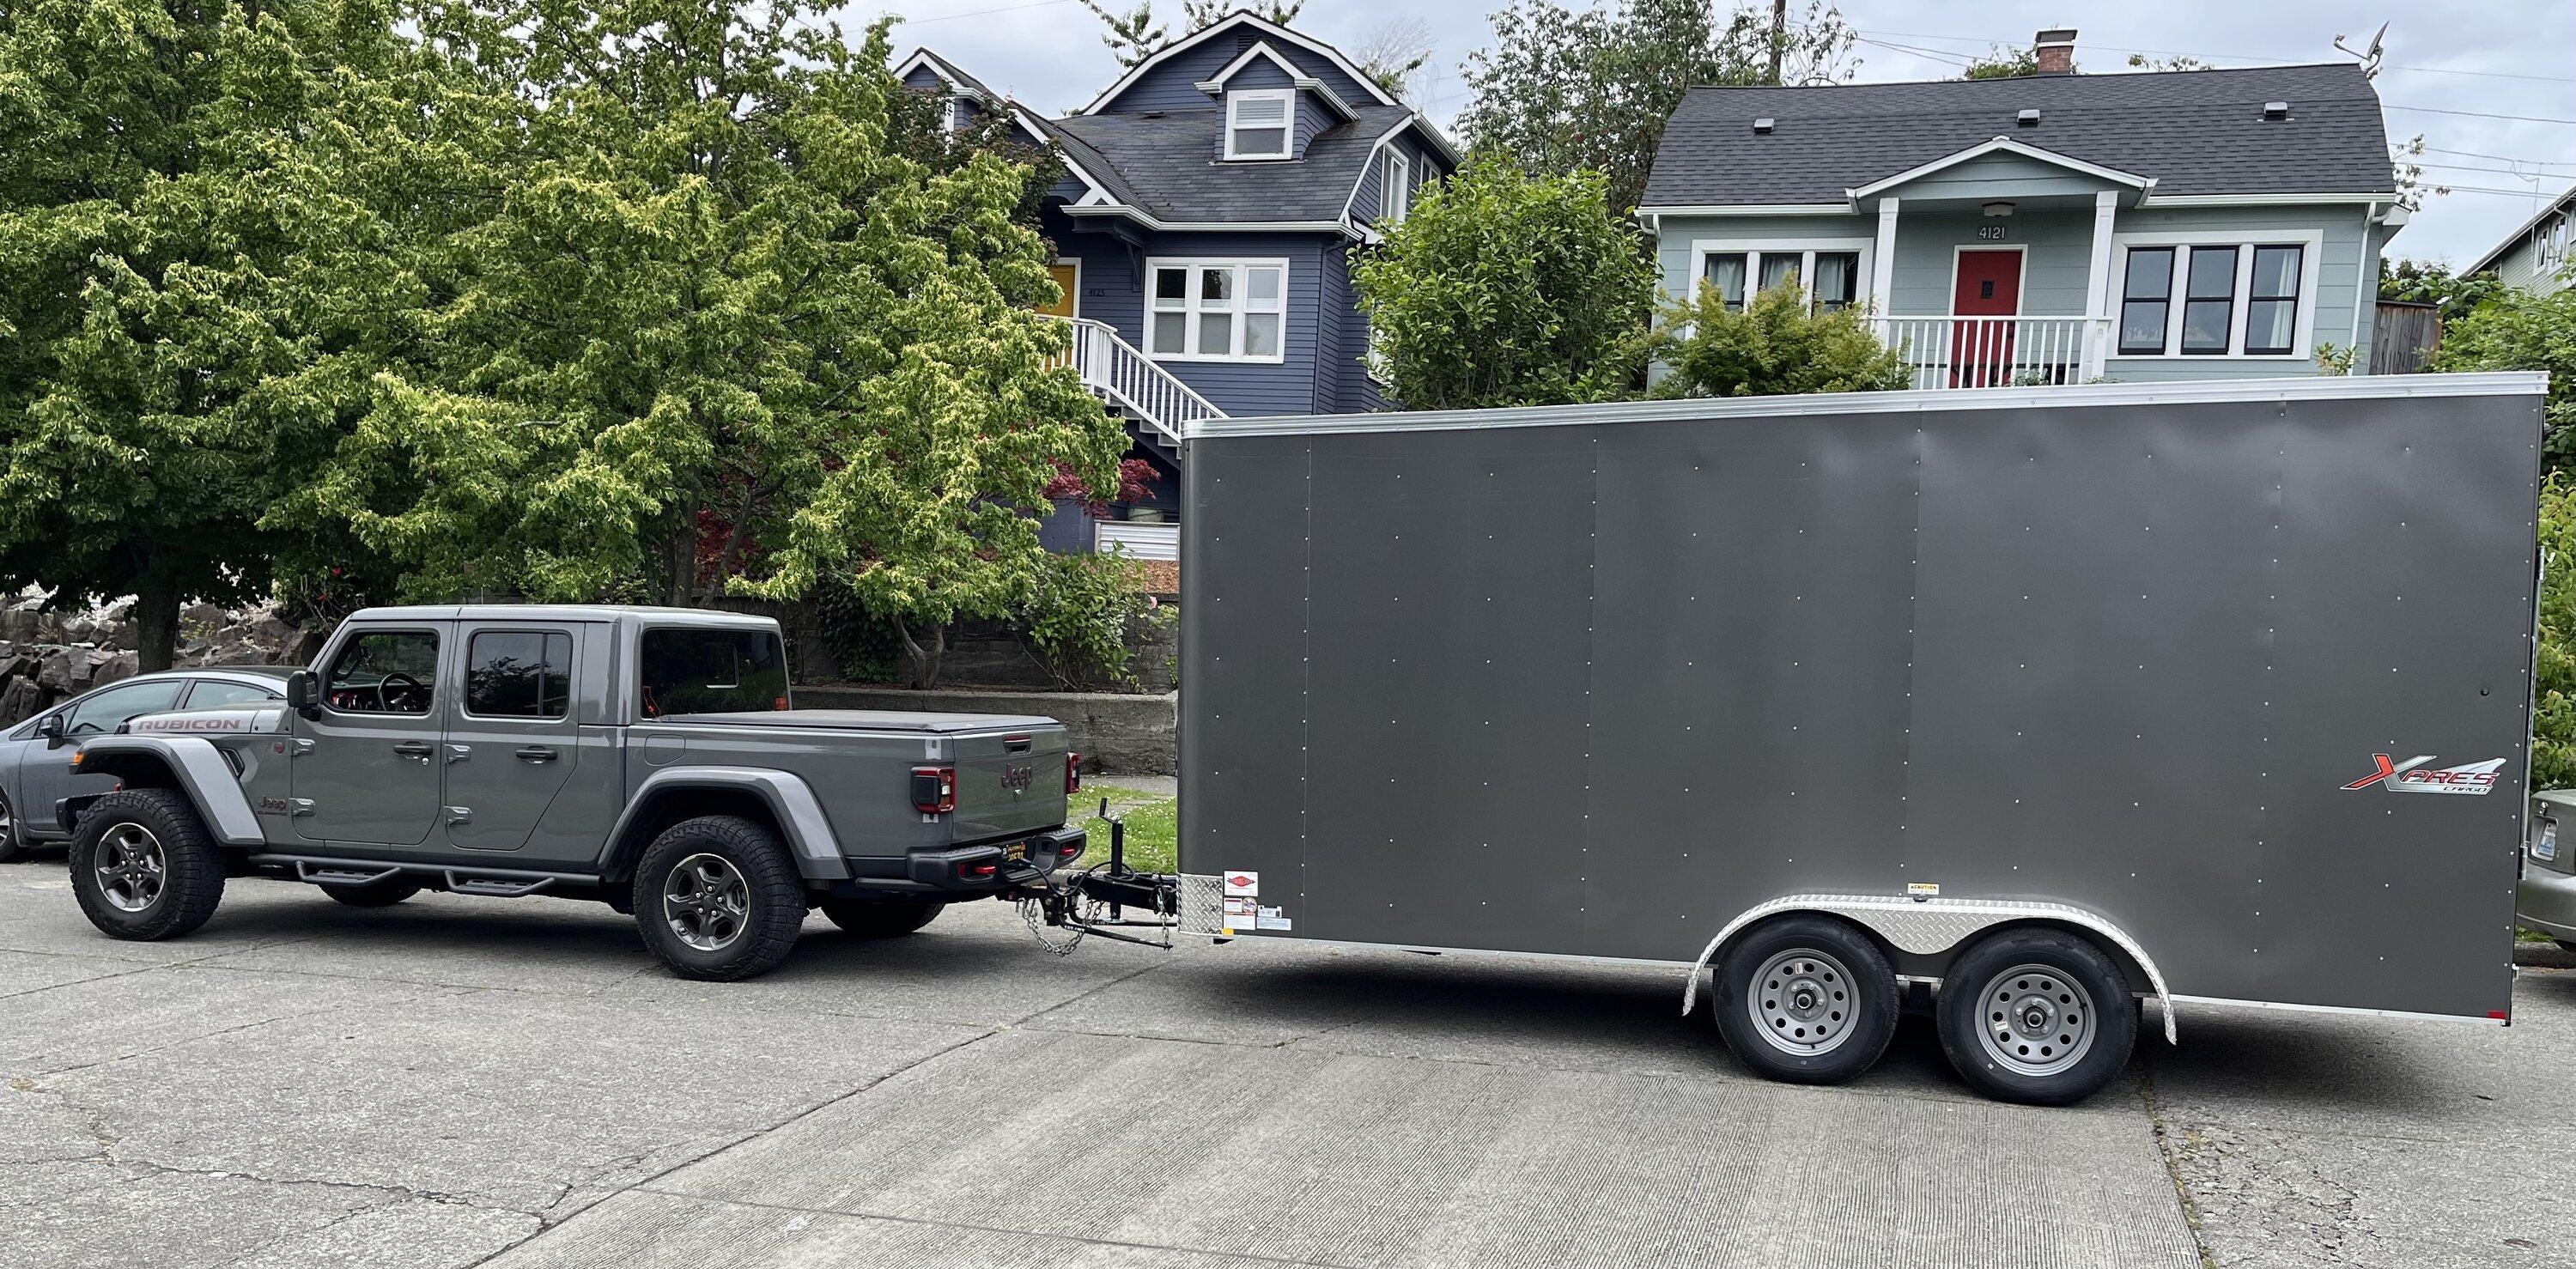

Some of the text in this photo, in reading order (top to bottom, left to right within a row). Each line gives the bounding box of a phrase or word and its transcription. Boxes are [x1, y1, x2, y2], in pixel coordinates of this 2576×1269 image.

[1978, 227, 2005, 240] 4121
[137, 720, 240, 730] RUBICON
[1001, 763, 1032, 790] Jeep
[258, 795, 287, 811] Jeep
